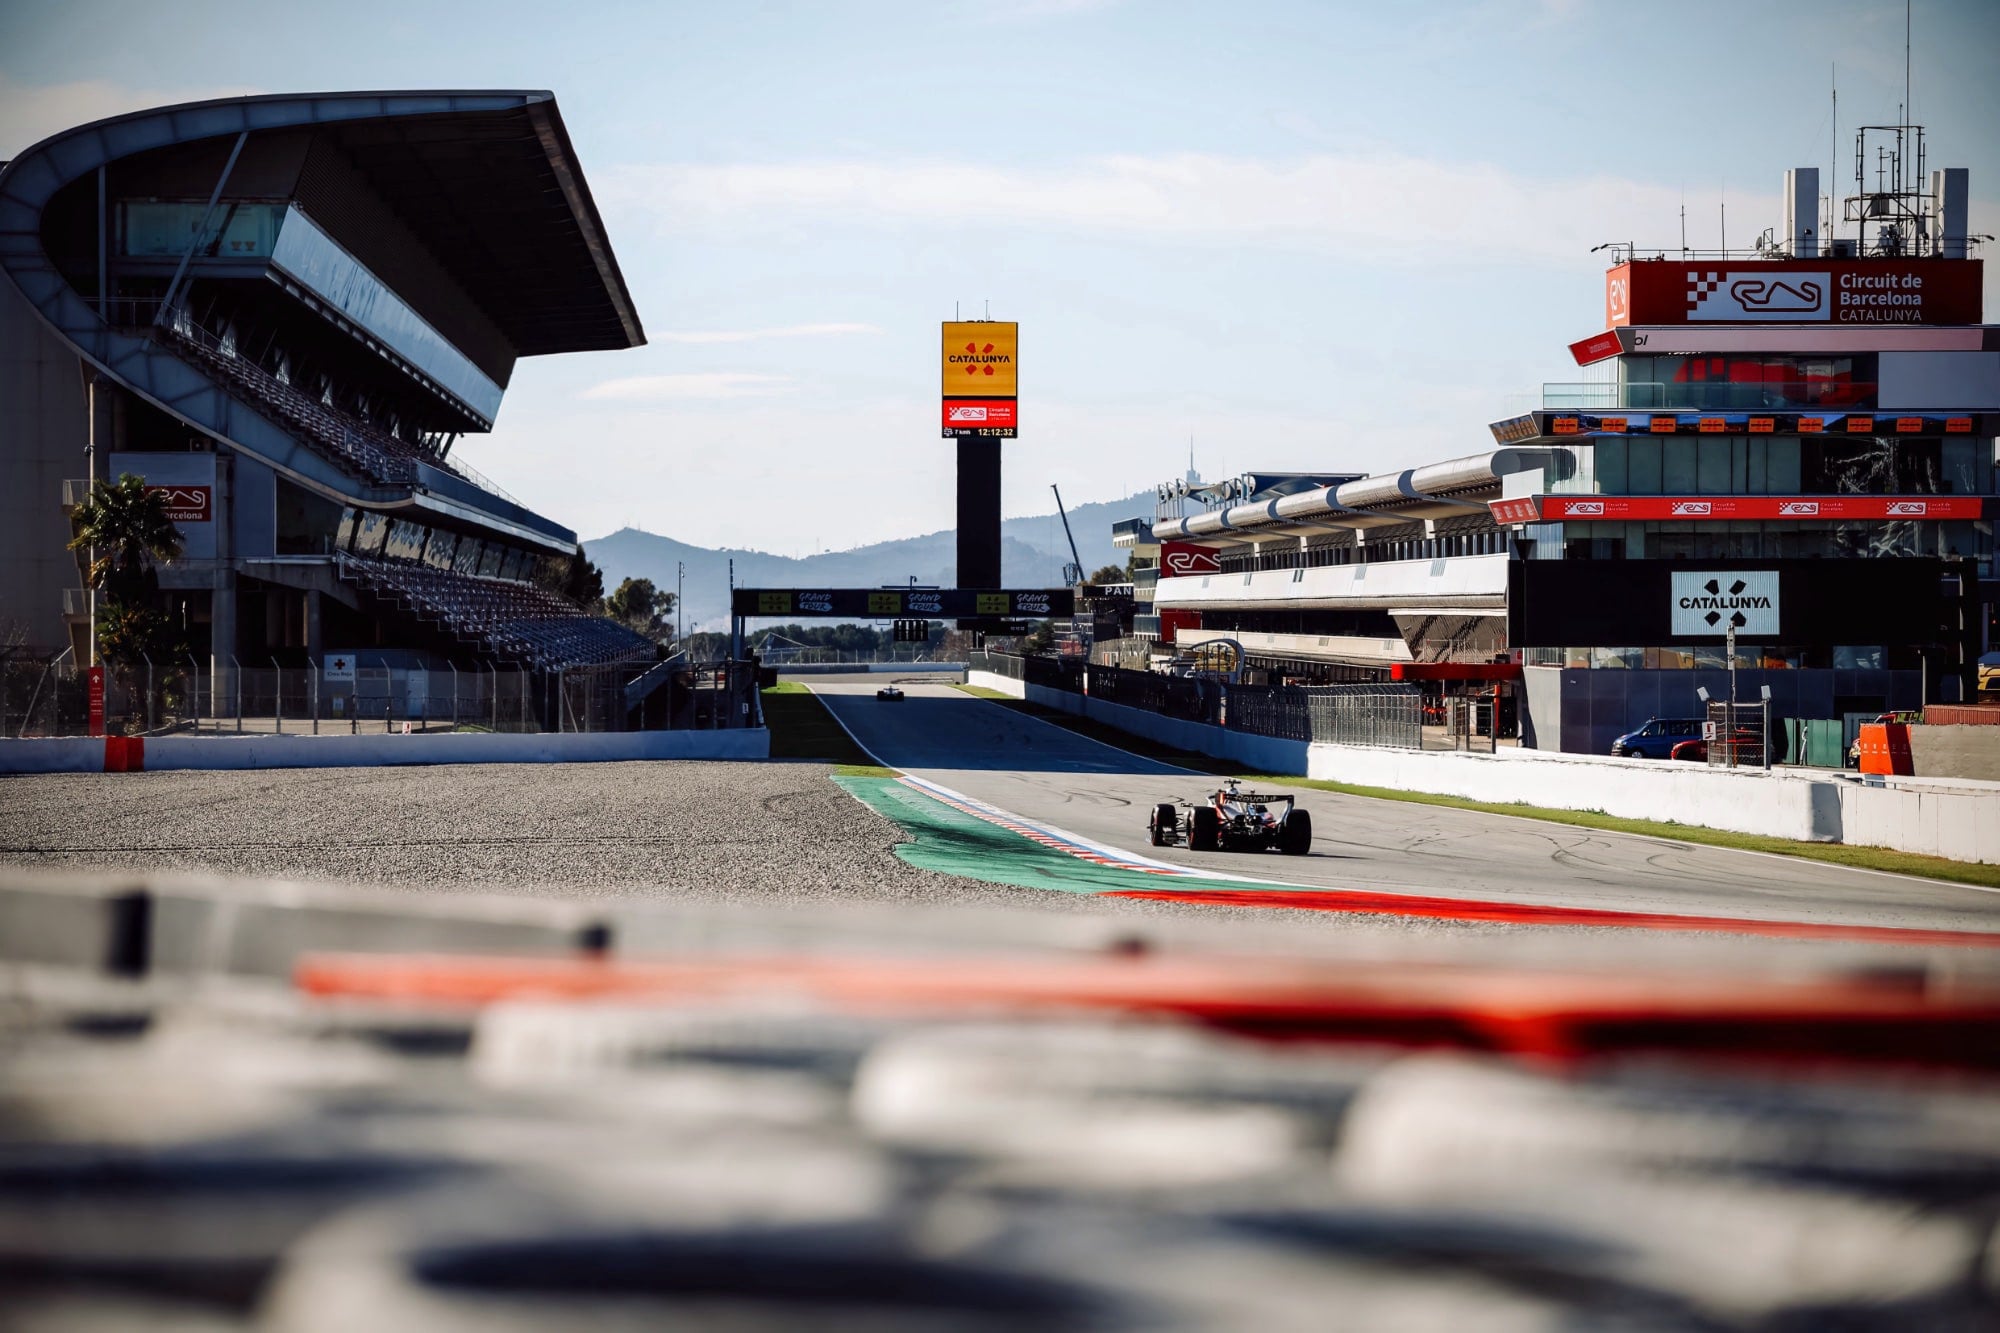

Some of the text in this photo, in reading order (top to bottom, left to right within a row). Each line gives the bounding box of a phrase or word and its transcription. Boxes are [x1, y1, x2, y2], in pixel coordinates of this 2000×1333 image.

[1840, 272, 1922, 288] Circuit de
[1840, 291, 1922, 305] Barcelona
[1839, 309, 1922, 321] CATALUNYA
[949, 355, 1010, 363] CATALUNYA
[978, 428, 1013, 436] 12:12:32
[165, 511, 203, 519] arcelona
[799, 592, 832, 601] GRAND
[908, 593, 941, 602] GRAND
[1017, 593, 1050, 602] GRAND
[802, 602, 828, 610] TOUR
[912, 602, 937, 611] TOUR
[1021, 603, 1045, 611] TOUR
[1680, 597, 1771, 609] CATALUNYA
